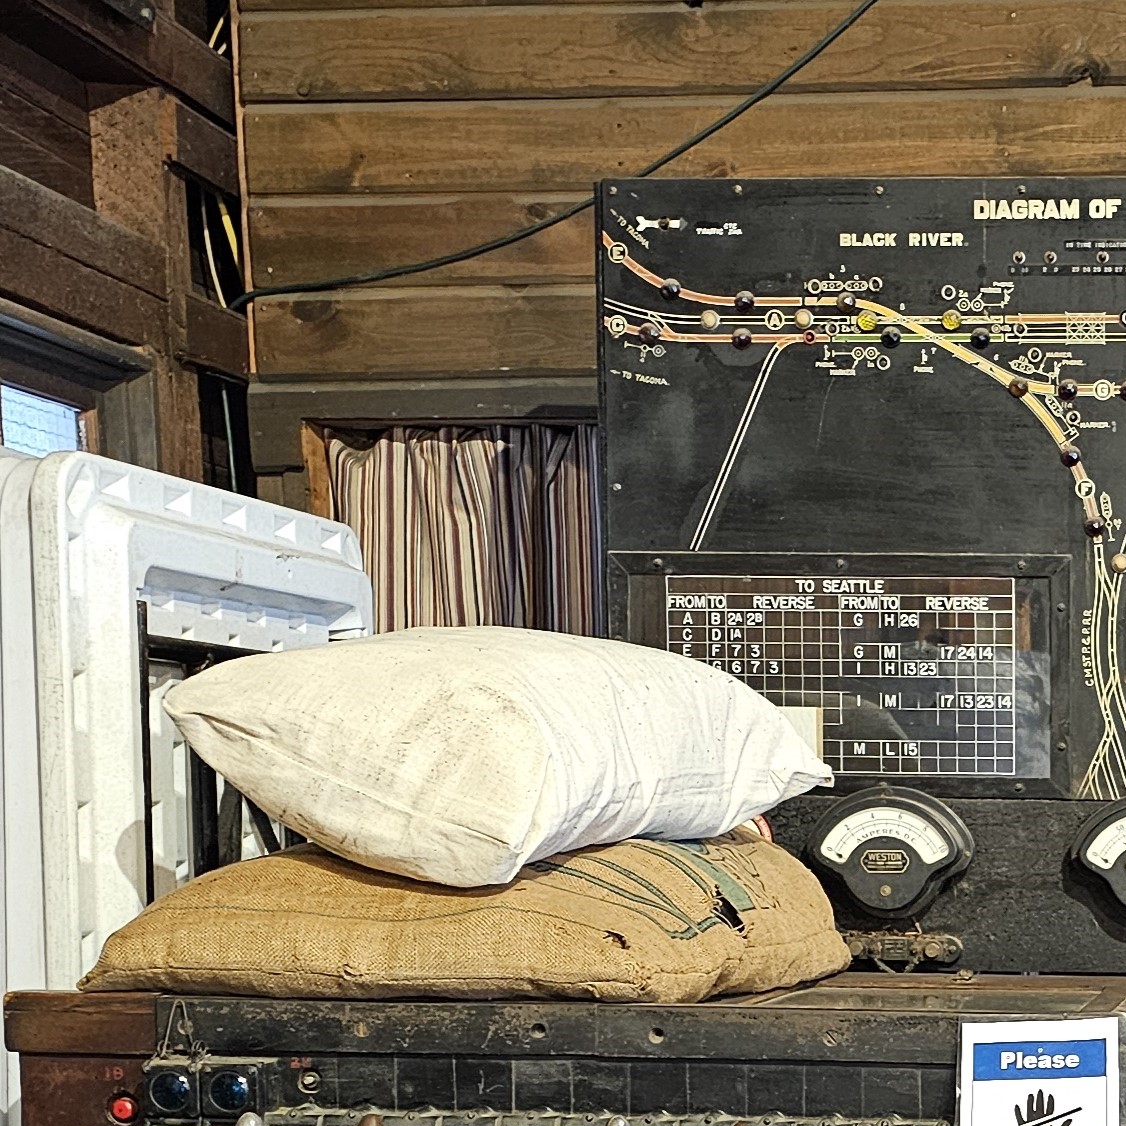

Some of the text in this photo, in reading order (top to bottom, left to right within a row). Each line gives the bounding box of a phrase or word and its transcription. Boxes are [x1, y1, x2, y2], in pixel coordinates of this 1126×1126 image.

[973, 199, 1080, 220] DIAGRAM
[1088, 198, 1121, 219] OF
[839, 232, 897, 247] BLACK
[613, 246, 624, 260] E
[769, 312, 780, 325] A
[621, 370, 632, 379] TO
[1096, 382, 1109, 396] G
[1080, 482, 1092, 497] F
[795, 579, 884, 594] TO SEATTLE
[667, 595, 989, 611] FROM TO REVERSE FROM TO REVERSE
[682, 611, 918, 627] A B 2A 2B G H 26
[682, 628, 693, 641] C
[711, 628, 722, 641] D
[682, 644, 993, 660] E F 7 3 G M 17 24 14
[731, 660, 937, 676] 6 7 3 H 13 23
[884, 694, 1012, 709] M 17 13 23 14
[853, 742, 918, 756] M L 15
[868, 852, 902, 861] WESTON
[1000, 1050, 1080, 1070] Please
